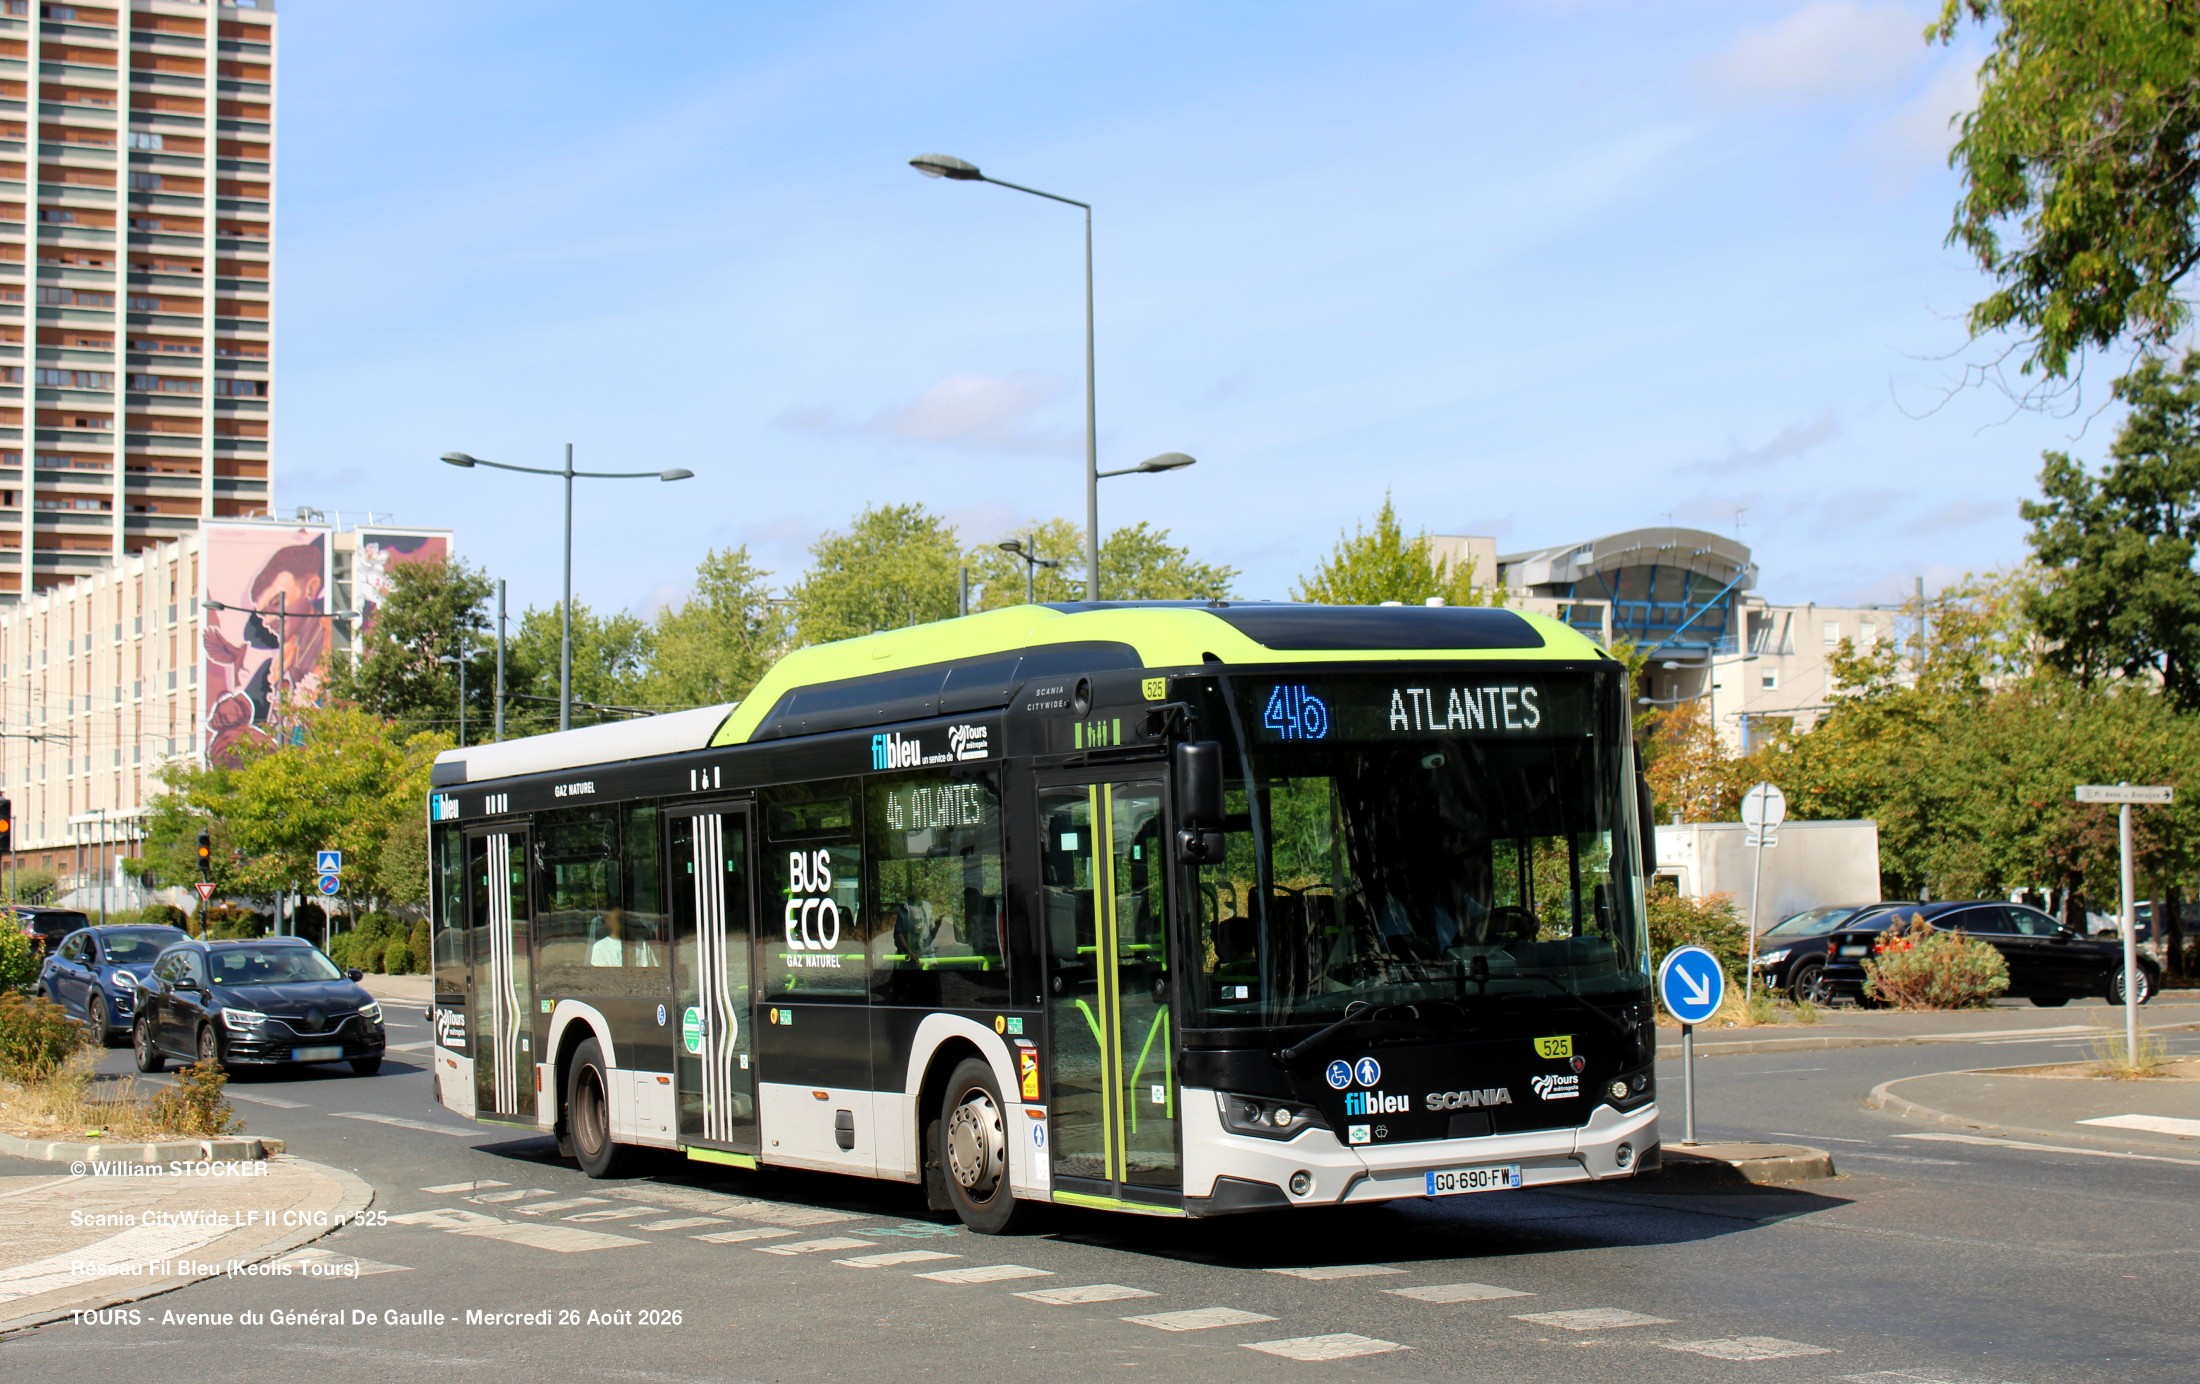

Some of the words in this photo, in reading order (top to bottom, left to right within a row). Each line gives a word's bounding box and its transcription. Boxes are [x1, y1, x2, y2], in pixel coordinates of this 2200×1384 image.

[1036, 686, 1064, 696] SCANIA
[1148, 681, 1162, 697] 525
[1027, 700, 1062, 711] CITYWIDE
[1265, 686, 1328, 739] 46
[1390, 687, 1540, 730] ATLANTES
[964, 725, 987, 739] Tours
[872, 732, 920, 770] filbleu
[922, 756, 928, 765] un
[929, 753, 946, 764] service
[947, 752, 953, 762] de
[555, 785, 567, 798] GAZ
[569, 782, 595, 795] NATUREL
[432, 793, 459, 820] filbleu
[912, 784, 980, 828] ATLANTES
[790, 849, 831, 892] BUS
[785, 898, 840, 950] ECO
[787, 955, 803, 968] GAZ
[806, 955, 840, 968] NATUREL
[448, 1010, 465, 1026] Tours
[1544, 1040, 1568, 1056] 525
[1552, 1075, 1578, 1085] Tours
[1345, 1091, 1410, 1115] filbleu
[1426, 1088, 1512, 1110] SCANIA
[1436, 1168, 1510, 1191] GQ-690-FW
[1511, 1177, 1519, 1185] 37
